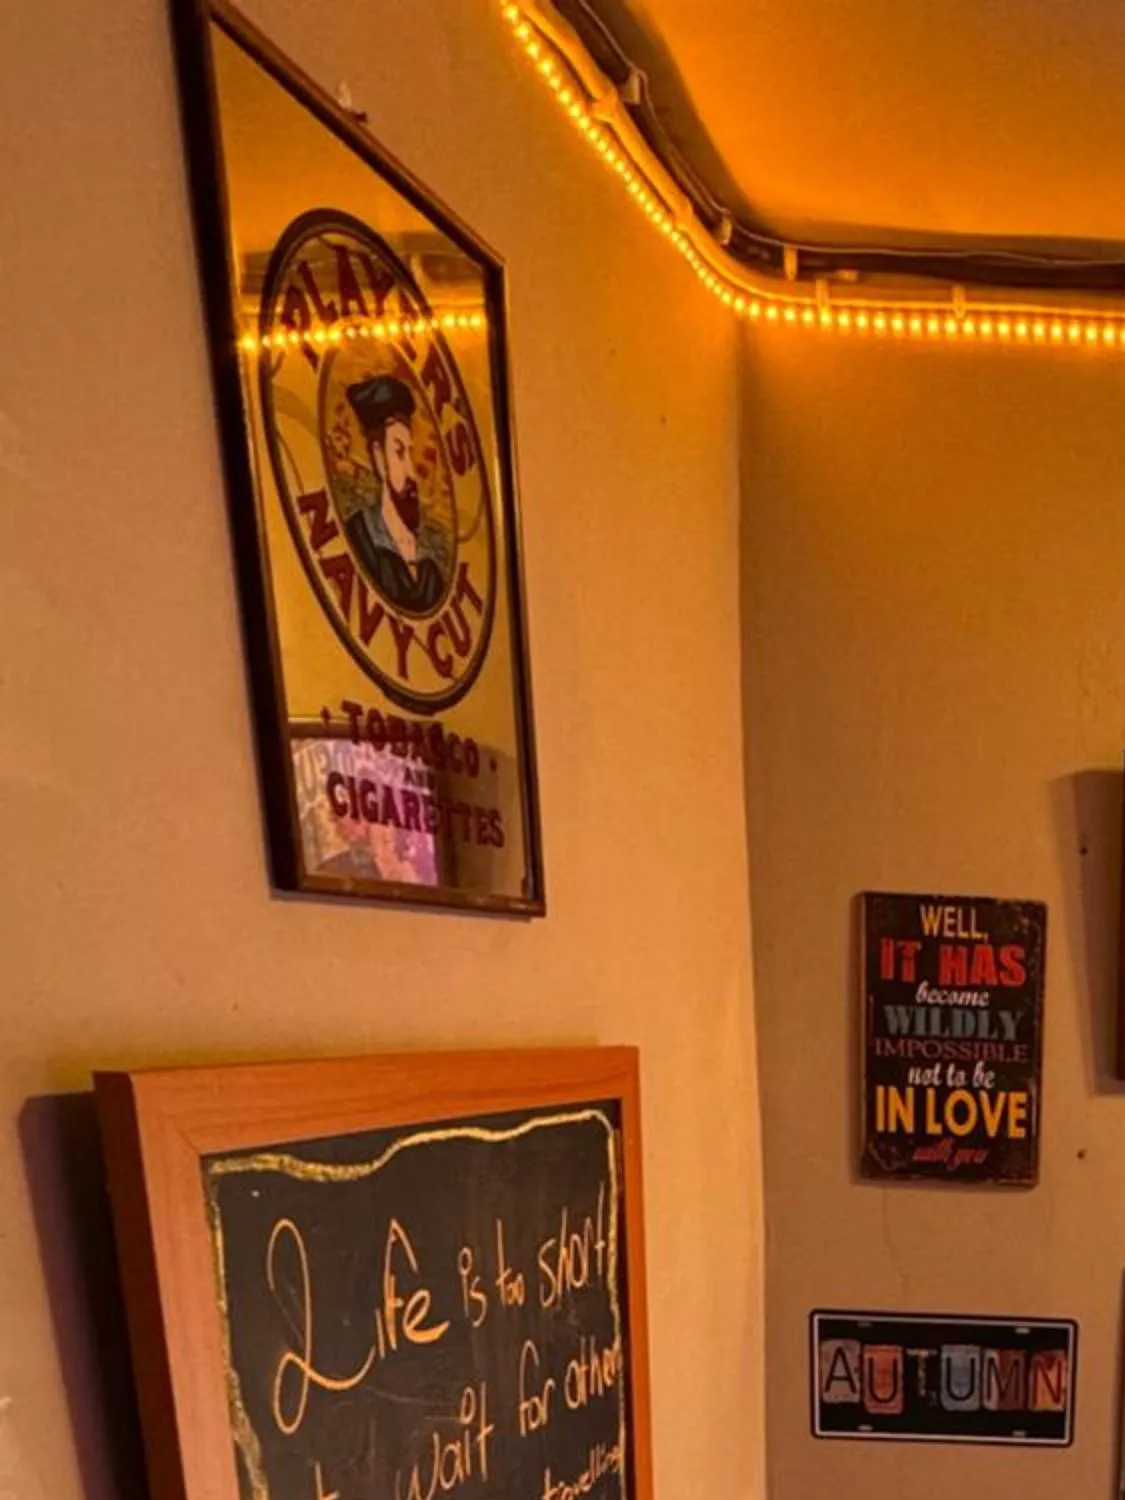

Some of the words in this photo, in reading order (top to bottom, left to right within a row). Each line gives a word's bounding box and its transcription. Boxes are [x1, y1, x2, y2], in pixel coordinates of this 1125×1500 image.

[296, 487, 419, 681] NAVY
[425, 560, 485, 681] CUT
[339, 698, 481, 779] TOBACCO
[326, 771, 506, 849] CIGARETTES
[879, 937, 923, 983] IT
[937, 943, 1027, 987] HAS
[883, 1003, 1025, 1042] WILDLY
[914, 979, 991, 1008] become
[872, 1036, 1031, 1064] IMPOSSIBLE
[907, 1062, 942, 1087] not
[945, 1062, 967, 1088] to
[971, 1060, 997, 1090] be
[875, 1085, 916, 1134] IN
[926, 1088, 1029, 1139] LOVE
[266, 1218, 451, 1436] Life
[457, 1246, 488, 1328] is
[518, 1339, 556, 1437] for
[821, 1342, 1067, 1408] AUTUMN
